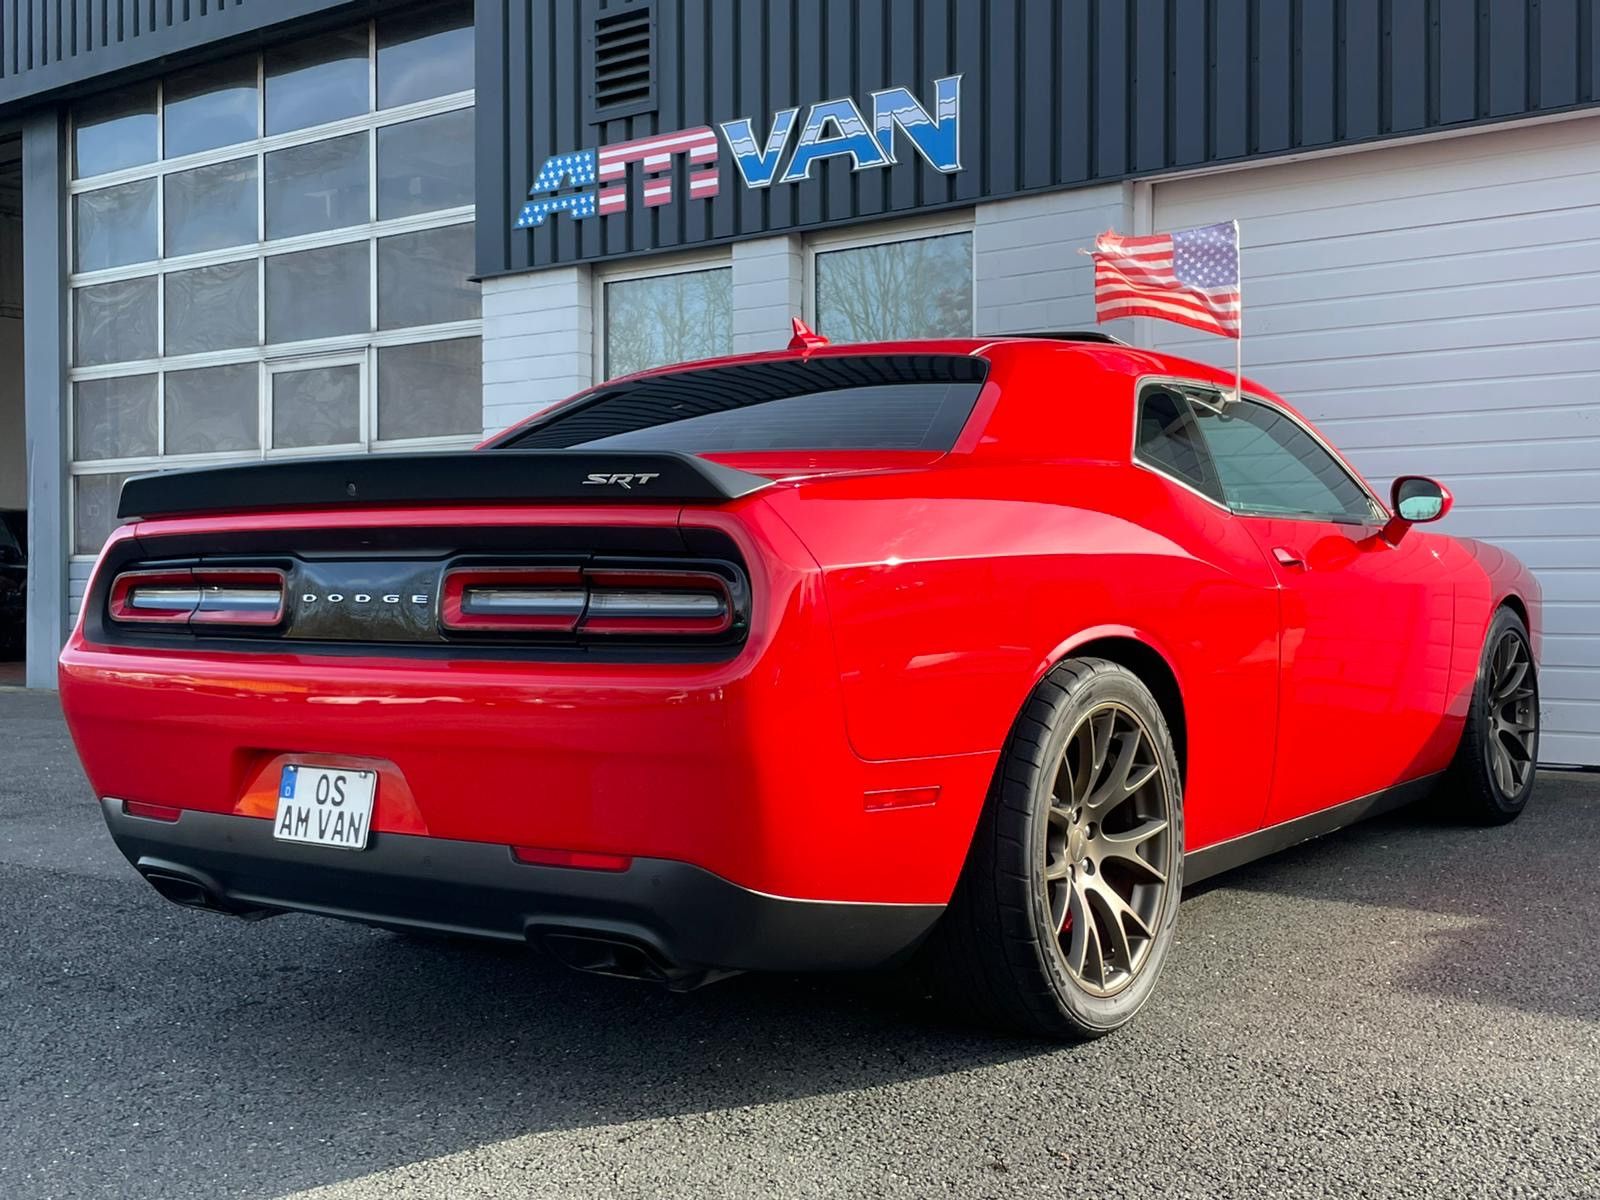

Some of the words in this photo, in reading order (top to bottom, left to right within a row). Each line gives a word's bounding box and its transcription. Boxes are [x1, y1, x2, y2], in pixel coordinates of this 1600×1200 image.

[582, 473, 660, 489] SRT
[302, 593, 429, 604] DODGE
[284, 786, 291, 797] D
[316, 774, 347, 807] OS
[280, 805, 311, 838] AM
[319, 808, 363, 843] VAN
